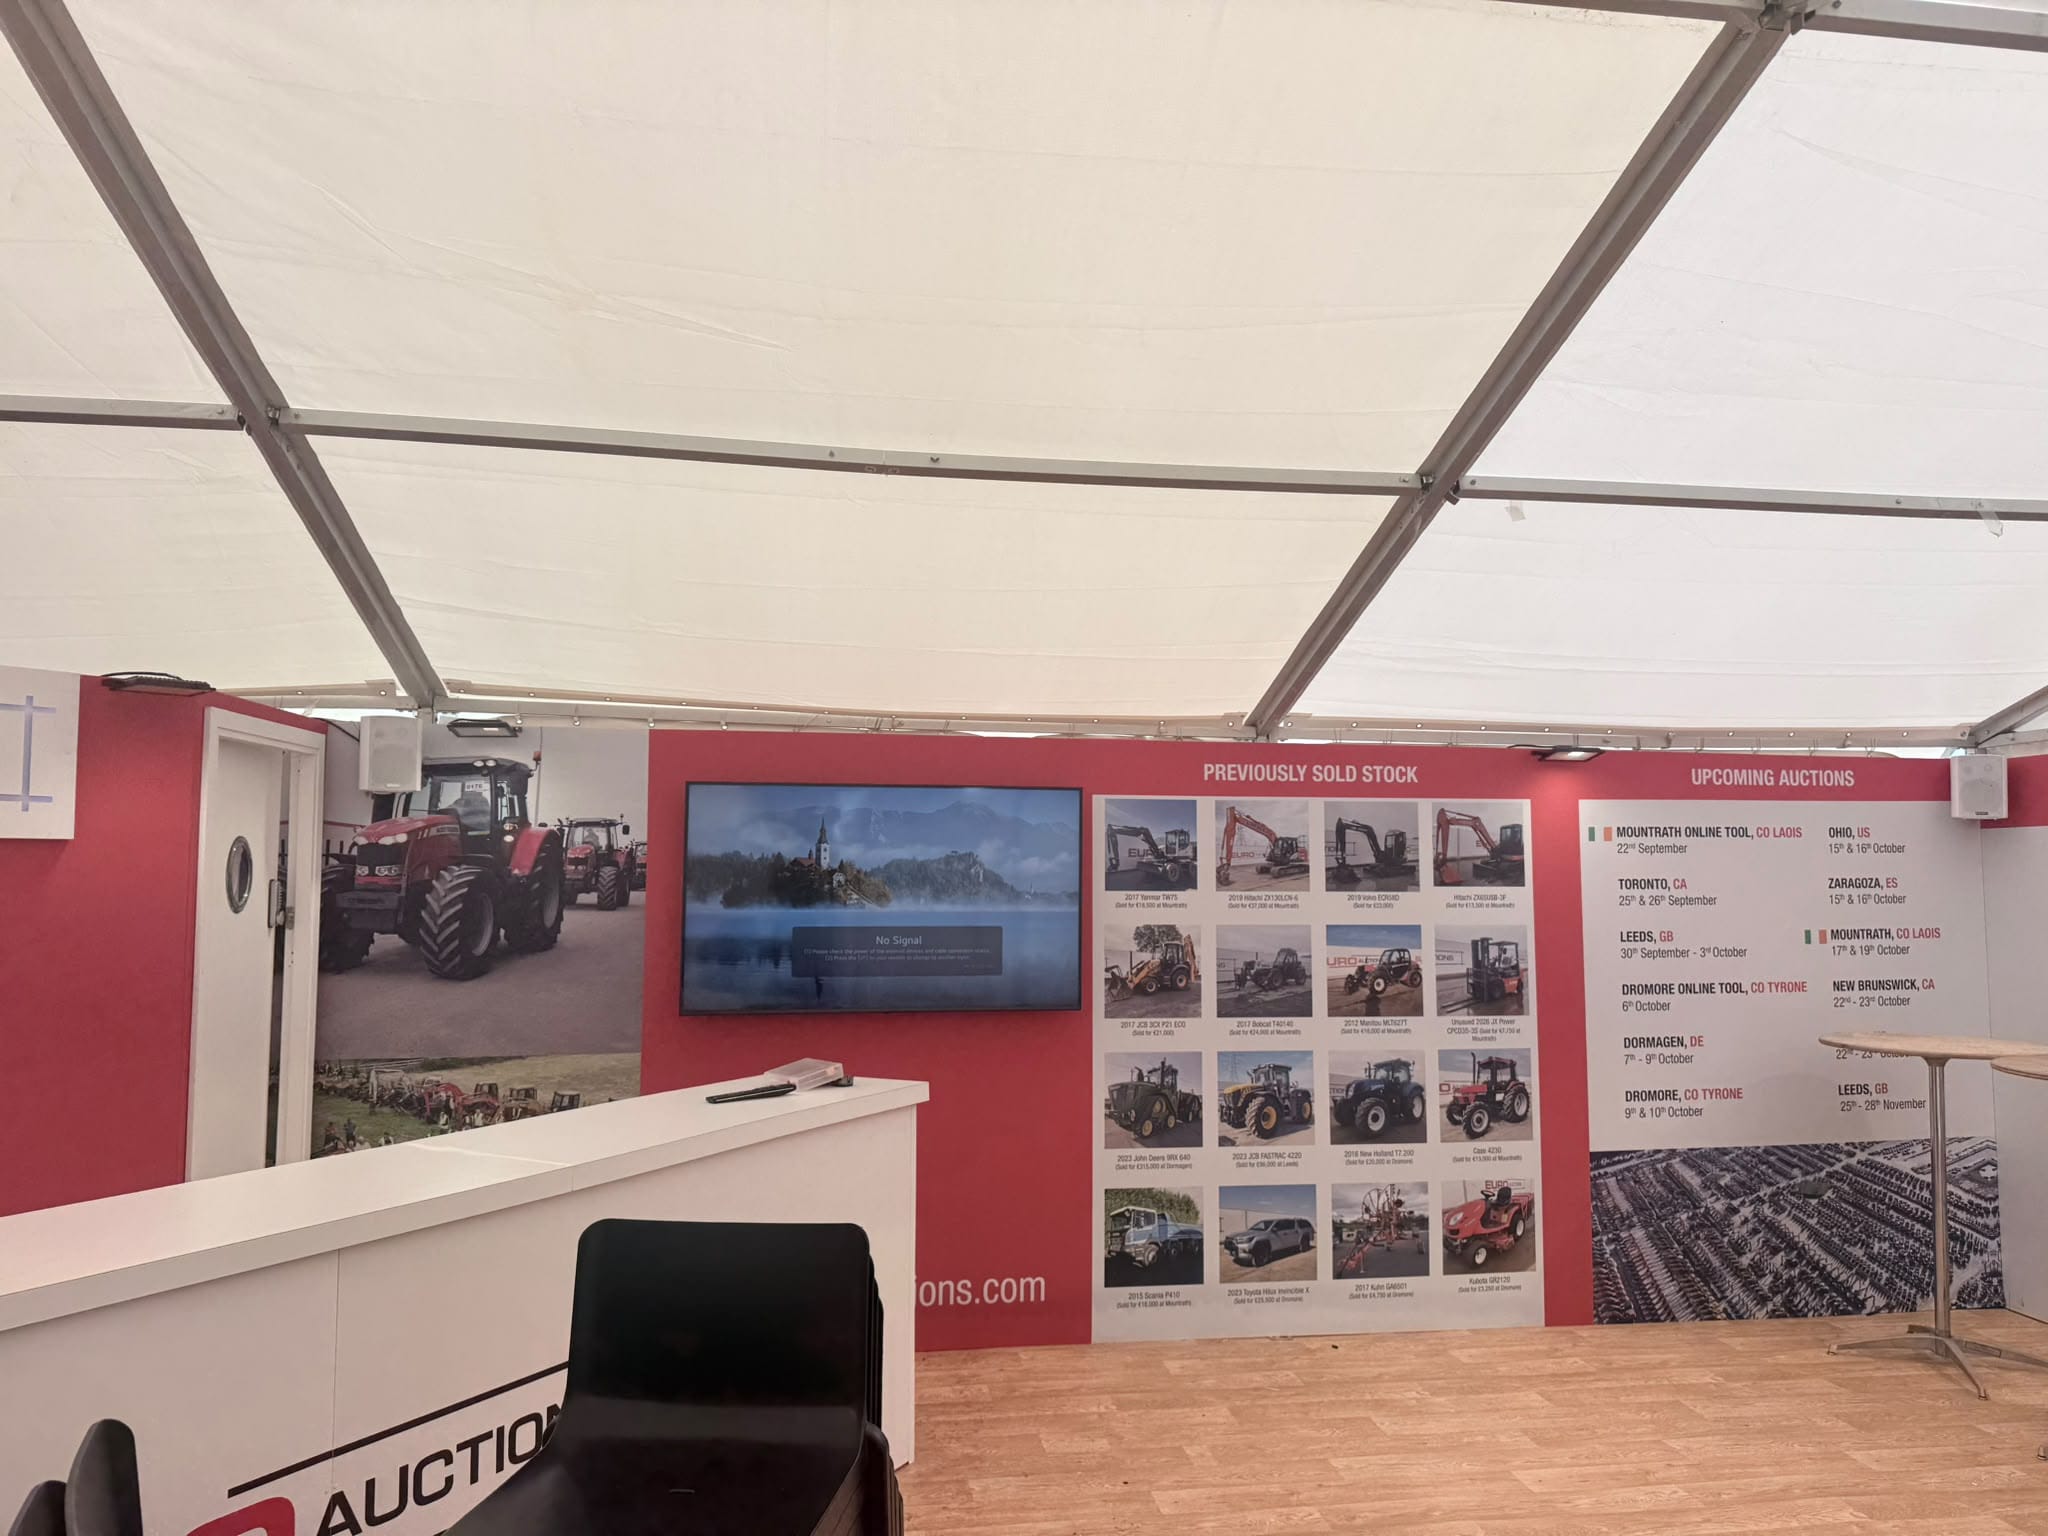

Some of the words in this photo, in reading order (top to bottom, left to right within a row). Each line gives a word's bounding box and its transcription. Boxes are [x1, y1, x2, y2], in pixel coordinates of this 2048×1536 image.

[1204, 763, 1308, 782] PREVIOUSLY
[1311, 764, 1357, 782] SOLD
[1362, 765, 1418, 783] STOCK
[1691, 768, 1775, 786] UPCOMING
[1778, 770, 1855, 787] AUCTIONS
[1616, 826, 1682, 838] MOUNTRATH
[1684, 826, 1722, 838] ONLINE
[1724, 826, 1754, 840] TOOL,
[1756, 826, 1769, 838] CO
[1772, 826, 1803, 838] LAOIS
[1828, 826, 1856, 840] OHIO,
[1857, 826, 1870, 838] US
[1638, 842, 1688, 856] September
[1846, 844, 1854, 854] &
[1873, 842, 1906, 854] October
[1618, 878, 1671, 892] TORONTO,
[1672, 878, 1688, 890] CA
[1828, 878, 1884, 890] ZARAGOZA,
[1886, 878, 1898, 888] ES
[1638, 896, 1646, 906] &
[1668, 894, 1717, 908] September
[1847, 894, 1854, 904] &
[1873, 893, 1906, 904] October
[1620, 930, 1657, 944] LEEDS,
[1659, 930, 1674, 942] GB
[1830, 928, 1894, 941] MOUNTRATH,
[1896, 928, 1910, 939] CO
[1912, 928, 1941, 938] LAOIS
[876, 936, 890, 944] No
[892, 936, 922, 948] Signal
[1640, 947, 1690, 961] September
[1712, 946, 1747, 958] October
[1850, 945, 1856, 956] &
[1877, 944, 1910, 955] October
[1622, 983, 1676, 996] DROMORE
[1678, 982, 1716, 995] ONLINE
[1718, 982, 1748, 996] TOOL,
[1750, 982, 1765, 994] CO
[1768, 980, 1808, 993] TYRONE
[1832, 980, 1856, 992] NEW
[1858, 979, 1920, 992] BRUNSWICK,
[1922, 978, 1936, 990] CA
[1635, 1000, 1671, 1012] October
[1878, 995, 1911, 1006] October
[1624, 1036, 1688, 1050] DORMAGEN,
[1690, 1036, 1704, 1047] DE
[1658, 1053, 1694, 1064] October
[1625, 1089, 1682, 1104] DROMORE,
[1684, 1088, 1699, 1100] CO
[1701, 1088, 1744, 1100] TYRONE
[1838, 1084, 1873, 1097] LEEDS,
[1874, 1083, 1888, 1094] GB
[1883, 1098, 1926, 1110] November
[1639, 1108, 1646, 1118] &
[1667, 1106, 1704, 1118] October
[916, 1276, 1046, 1308] ons.com
